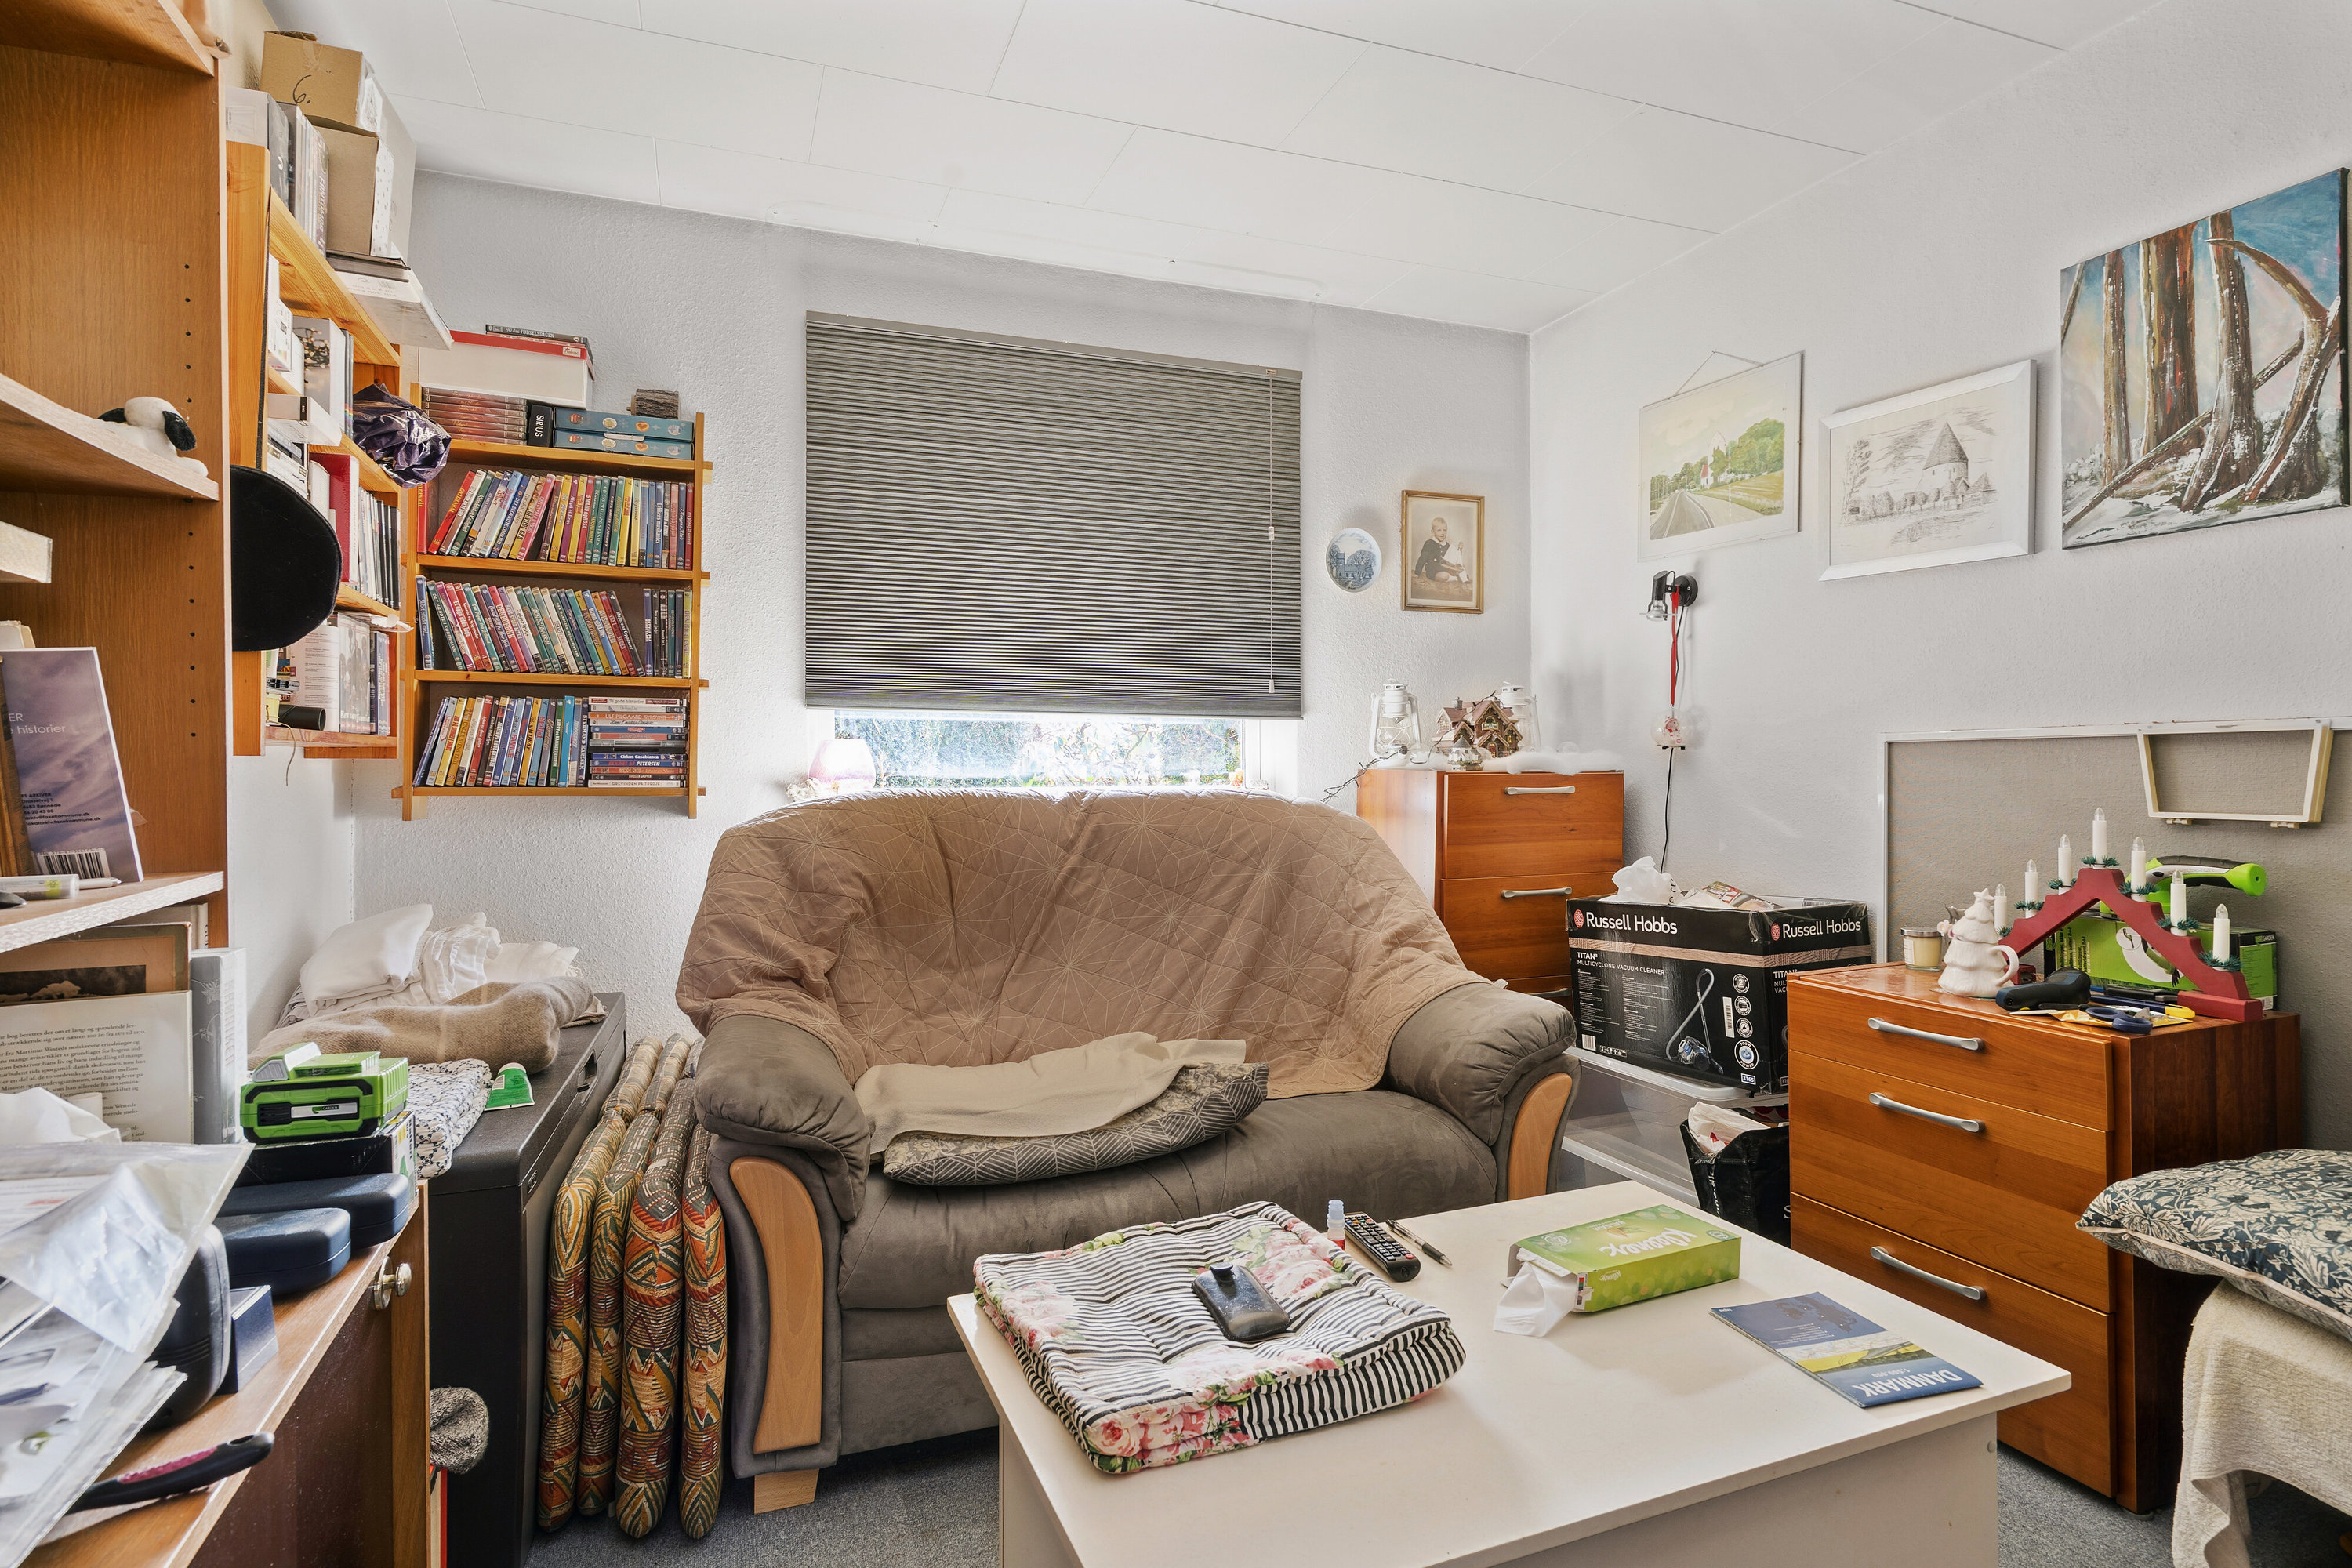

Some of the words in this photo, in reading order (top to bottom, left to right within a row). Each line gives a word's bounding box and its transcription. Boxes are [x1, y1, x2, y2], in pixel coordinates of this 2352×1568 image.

[534, 414, 544, 437] SIRIUS
[615, 611, 626, 630] Majorens
[622, 630, 633, 649] Oppasser
[17, 724, 66, 735] historier
[1585, 911, 1632, 931] Russell
[1634, 914, 1678, 935] Hobbs
[1782, 920, 1823, 938] Russell
[1826, 917, 1861, 934] Hobbs
[1577, 960, 1615, 969] MULTICYCLONE
[1617, 964, 1639, 972] VACUUM
[1639, 966, 1665, 975] CLEANER
[1742, 1075, 1755, 1083] 3165
[1599, 1226, 1698, 1257] Kleenex
[1599, 1270, 1622, 1282] Kleenex
[1851, 1368, 1963, 1398] DANMARK
